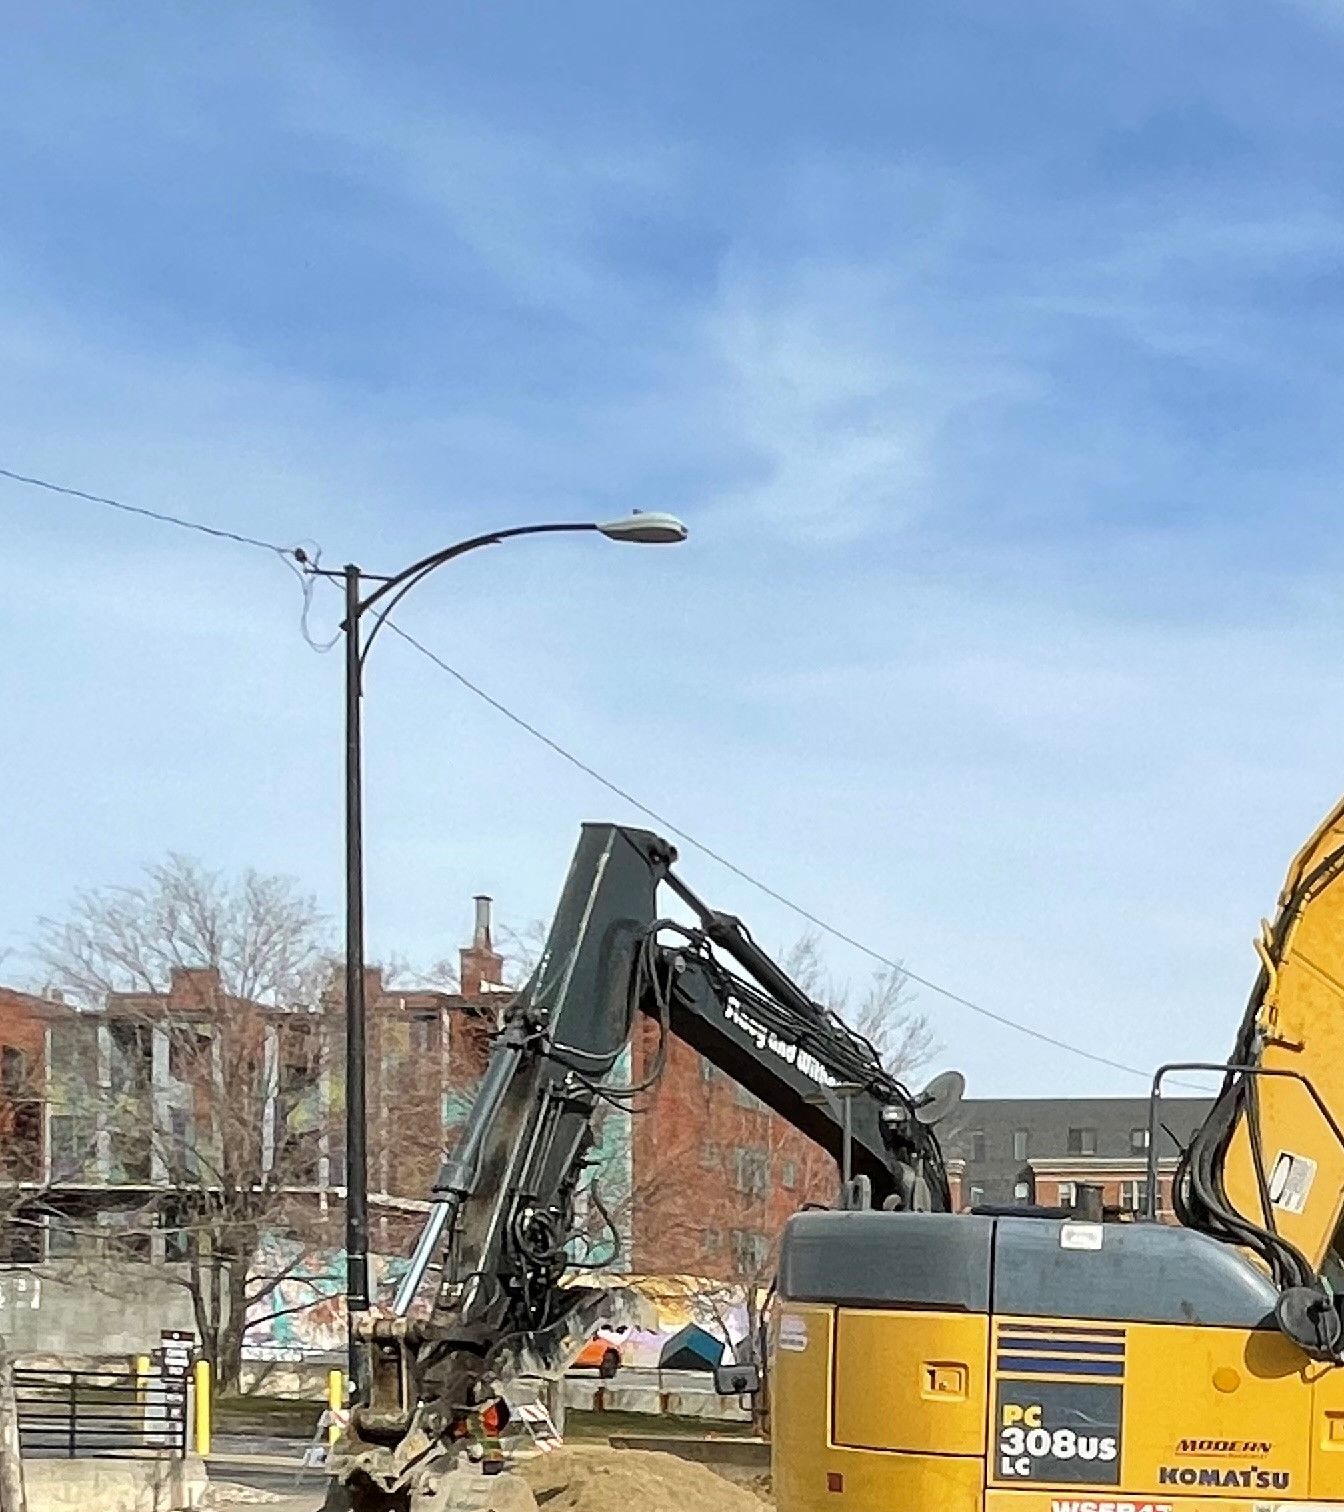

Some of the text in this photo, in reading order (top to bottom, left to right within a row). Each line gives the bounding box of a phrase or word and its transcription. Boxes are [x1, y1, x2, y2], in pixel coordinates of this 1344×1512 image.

[1002, 1404, 1042, 1428] PC
[1177, 1439, 1272, 1453] MODERN
[1002, 1456, 1031, 1476] LC
[1159, 1465, 1290, 1490] KOMATSU
